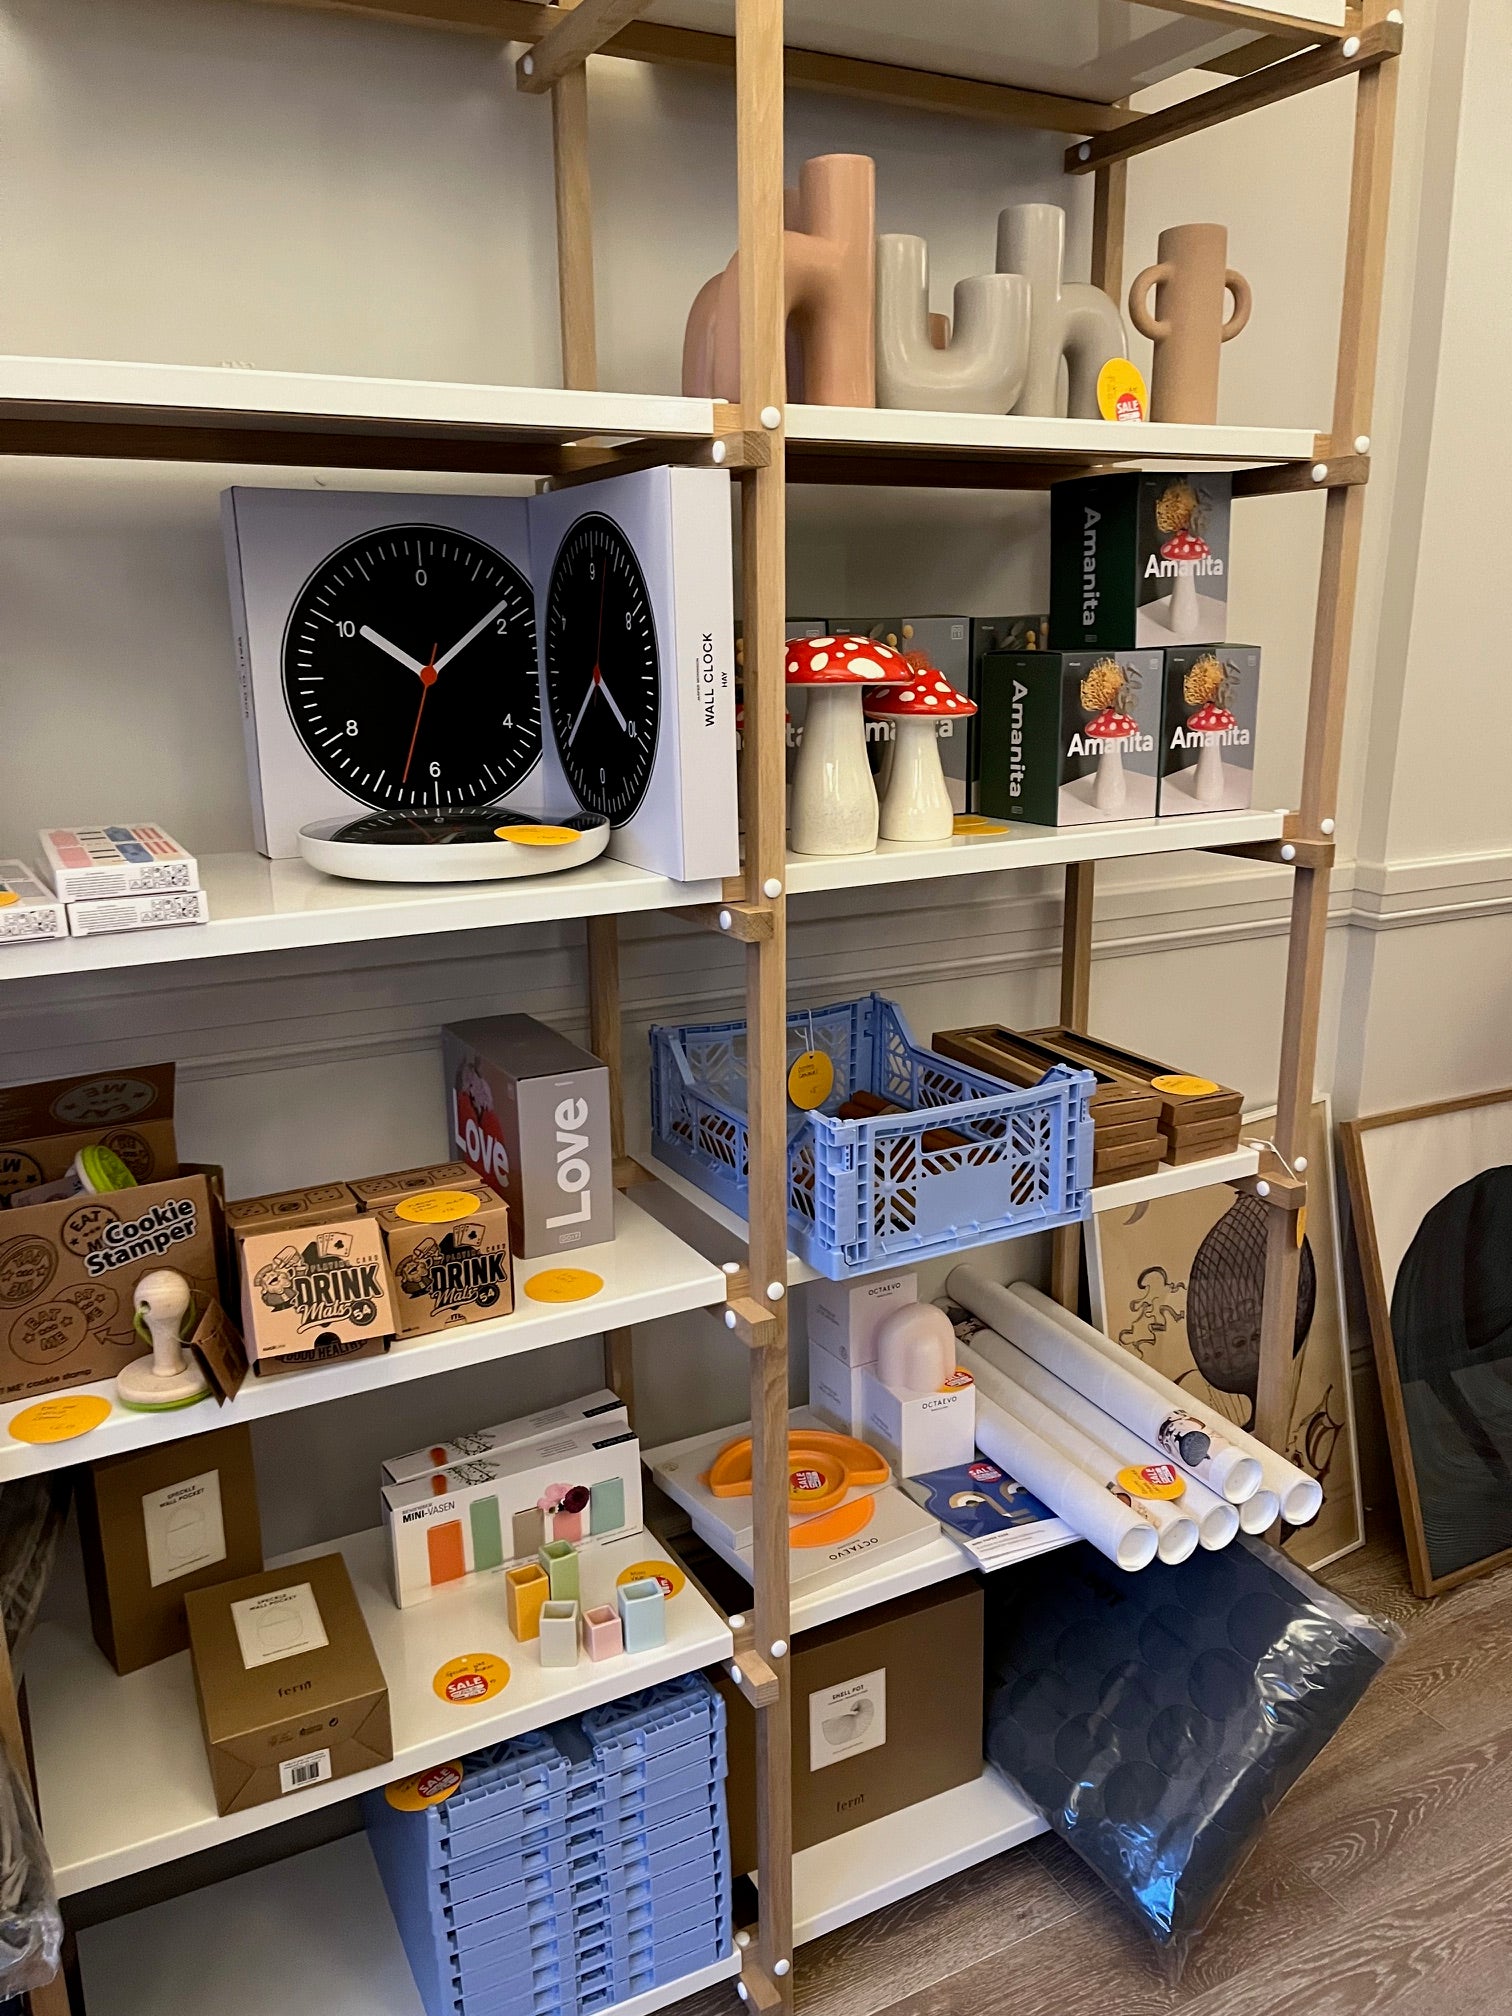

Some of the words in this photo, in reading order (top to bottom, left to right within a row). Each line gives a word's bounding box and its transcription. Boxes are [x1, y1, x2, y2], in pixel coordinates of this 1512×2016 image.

[1116, 400, 1139, 414] SALE
[414, 569, 428, 586] 0
[1082, 506, 1102, 626] Amanita
[1144, 554, 1224, 578] Amanita
[335, 620, 356, 638] 10
[496, 618, 508, 635] 2
[702, 633, 714, 683] CLOCK
[704, 688, 715, 727] WALL
[345, 720, 359, 737] 8
[502, 713, 514, 729] 4
[1009, 680, 1029, 798] Amanita
[1066, 729, 1154, 757] Amanita
[1170, 723, 1250, 750] Amanita
[429, 761, 442, 778] 6
[453, 1088, 510, 1188] Love
[546, 1097, 592, 1229] Love
[70, 1210, 101, 1232] EAT
[104, 1201, 194, 1245] Cookie
[86, 1218, 195, 1275] Stamper
[430, 1253, 507, 1292] DRINK
[294, 1264, 382, 1305] DRINK
[868, 1282, 901, 1296] OCTAEVO
[24, 1308, 61, 1331] EAT
[26, 1376, 61, 1389] cookie
[922, 1396, 957, 1410] OCTAEVO
[796, 1472, 809, 1489] SALE
[968, 1465, 996, 1475] SALE
[1146, 1468, 1163, 1485] SALE
[402, 1501, 455, 1524] MINI-VASEN
[829, 1537, 879, 1560] OCTAEVO
[447, 1676, 482, 1693] SALE
[418, 1768, 451, 1794] SALE
